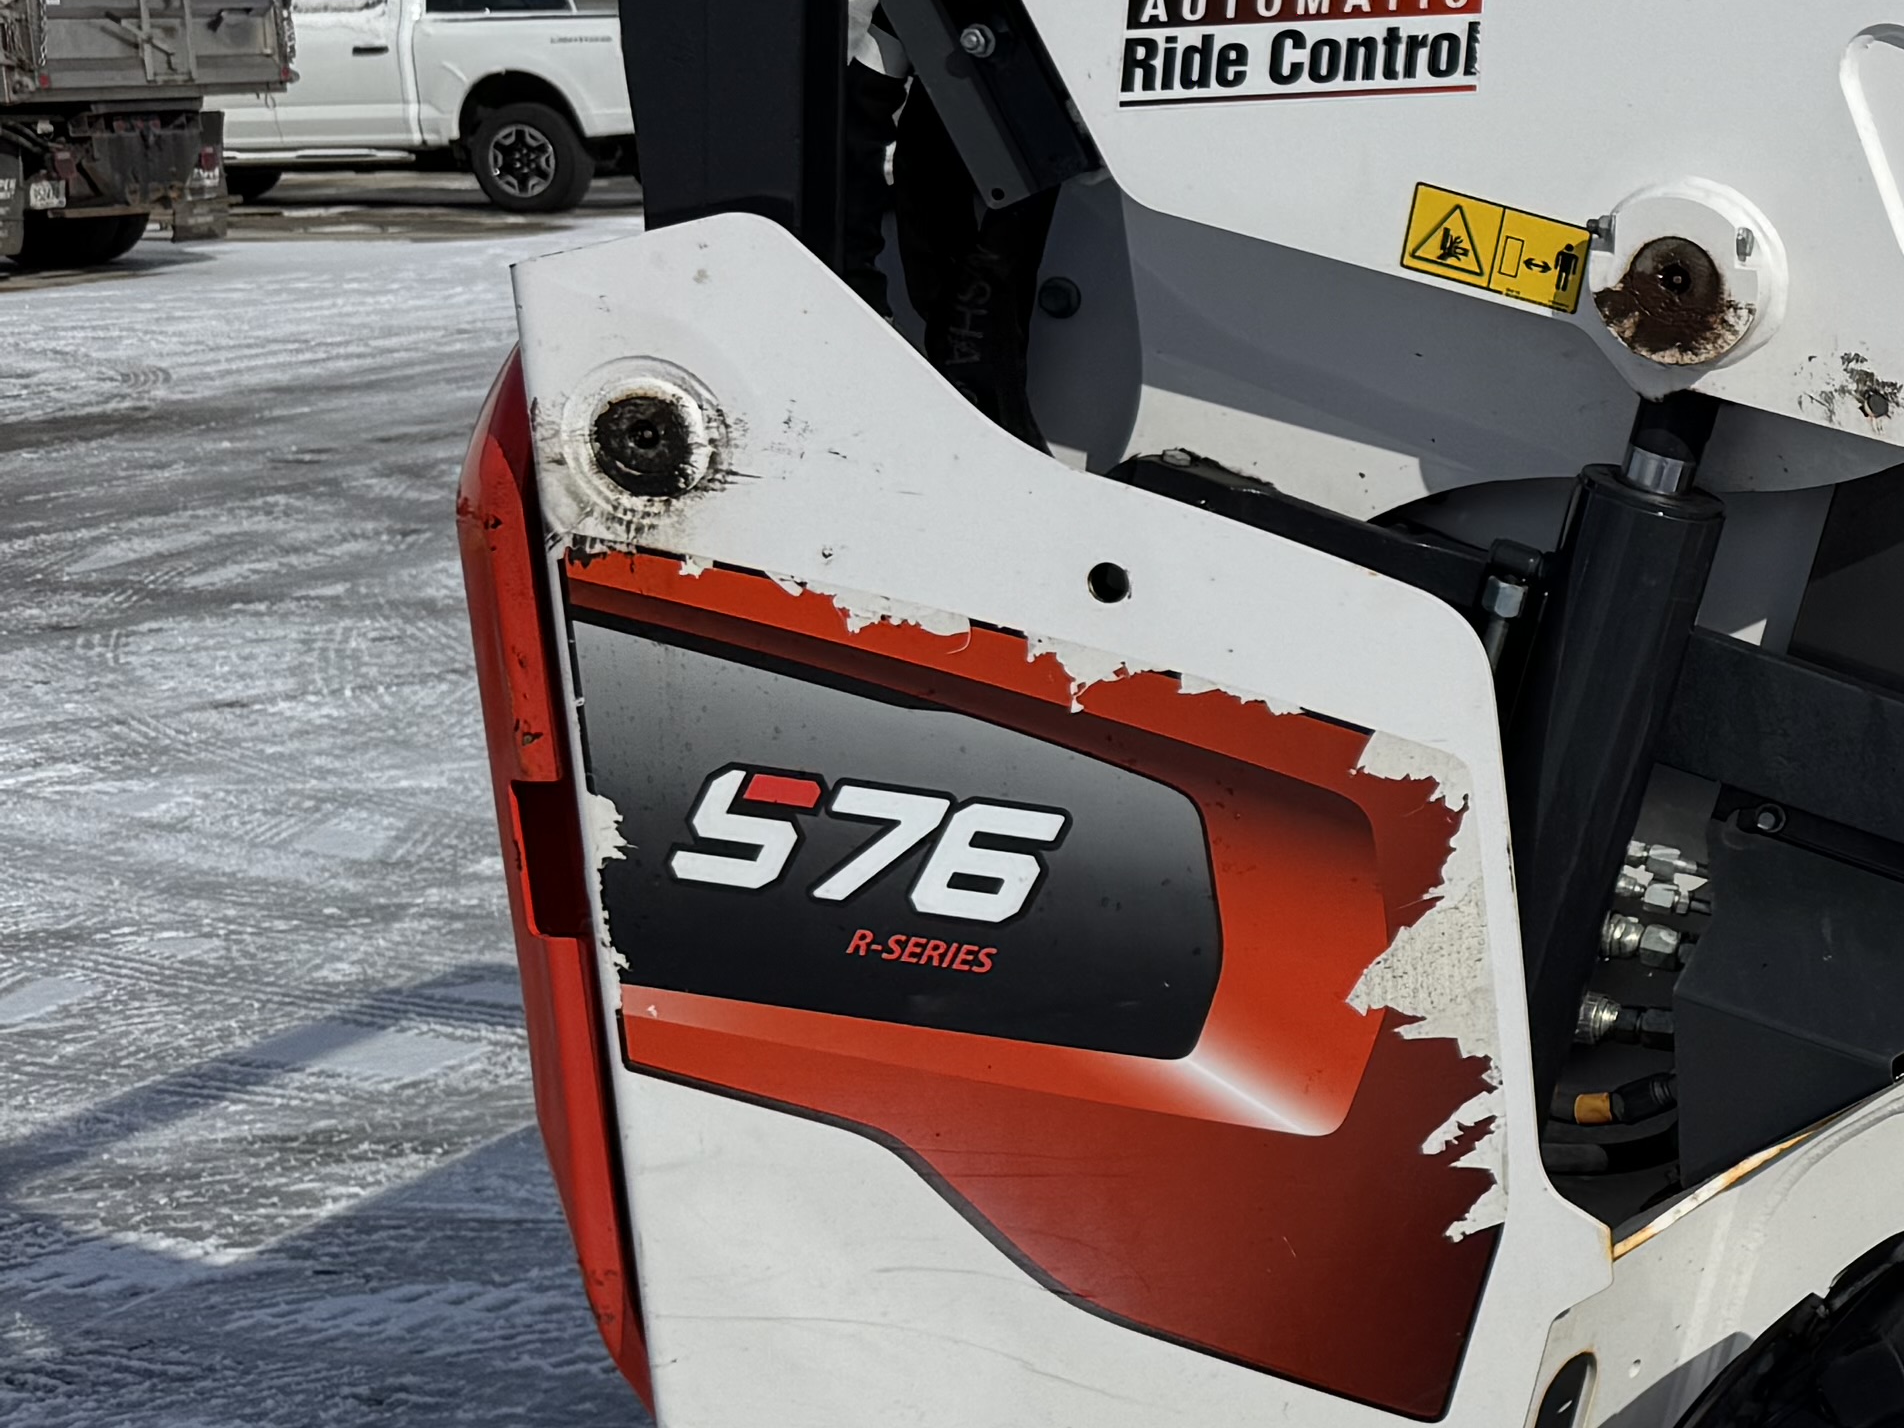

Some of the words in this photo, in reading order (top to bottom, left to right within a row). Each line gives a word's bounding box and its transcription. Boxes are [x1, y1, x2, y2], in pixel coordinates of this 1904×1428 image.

[1120, 33, 1250, 93] Ride
[1268, 21, 1482, 86] Control
[671, 769, 1066, 923] S76
[846, 928, 998, 974] R-SERIES
